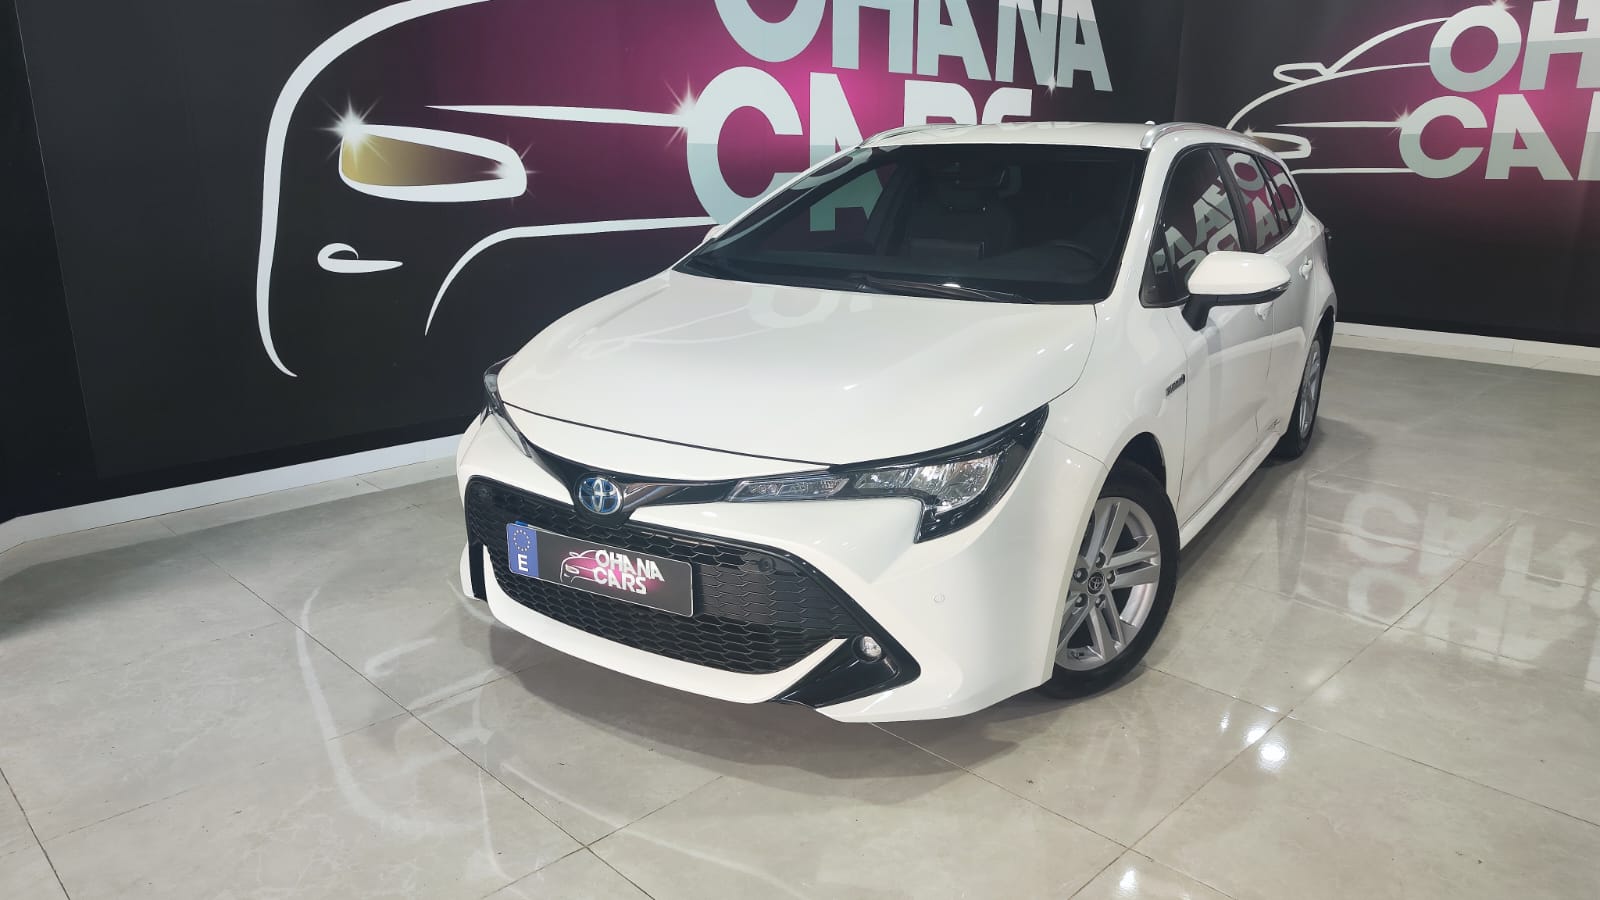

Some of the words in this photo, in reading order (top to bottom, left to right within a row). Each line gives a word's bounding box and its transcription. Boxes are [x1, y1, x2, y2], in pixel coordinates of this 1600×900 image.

[687, 66, 1033, 231] CA
[1399, 91, 1600, 181] CA
[517, 554, 529, 572] E
[594, 549, 665, 582] OHANA
[593, 566, 647, 595] CARS
